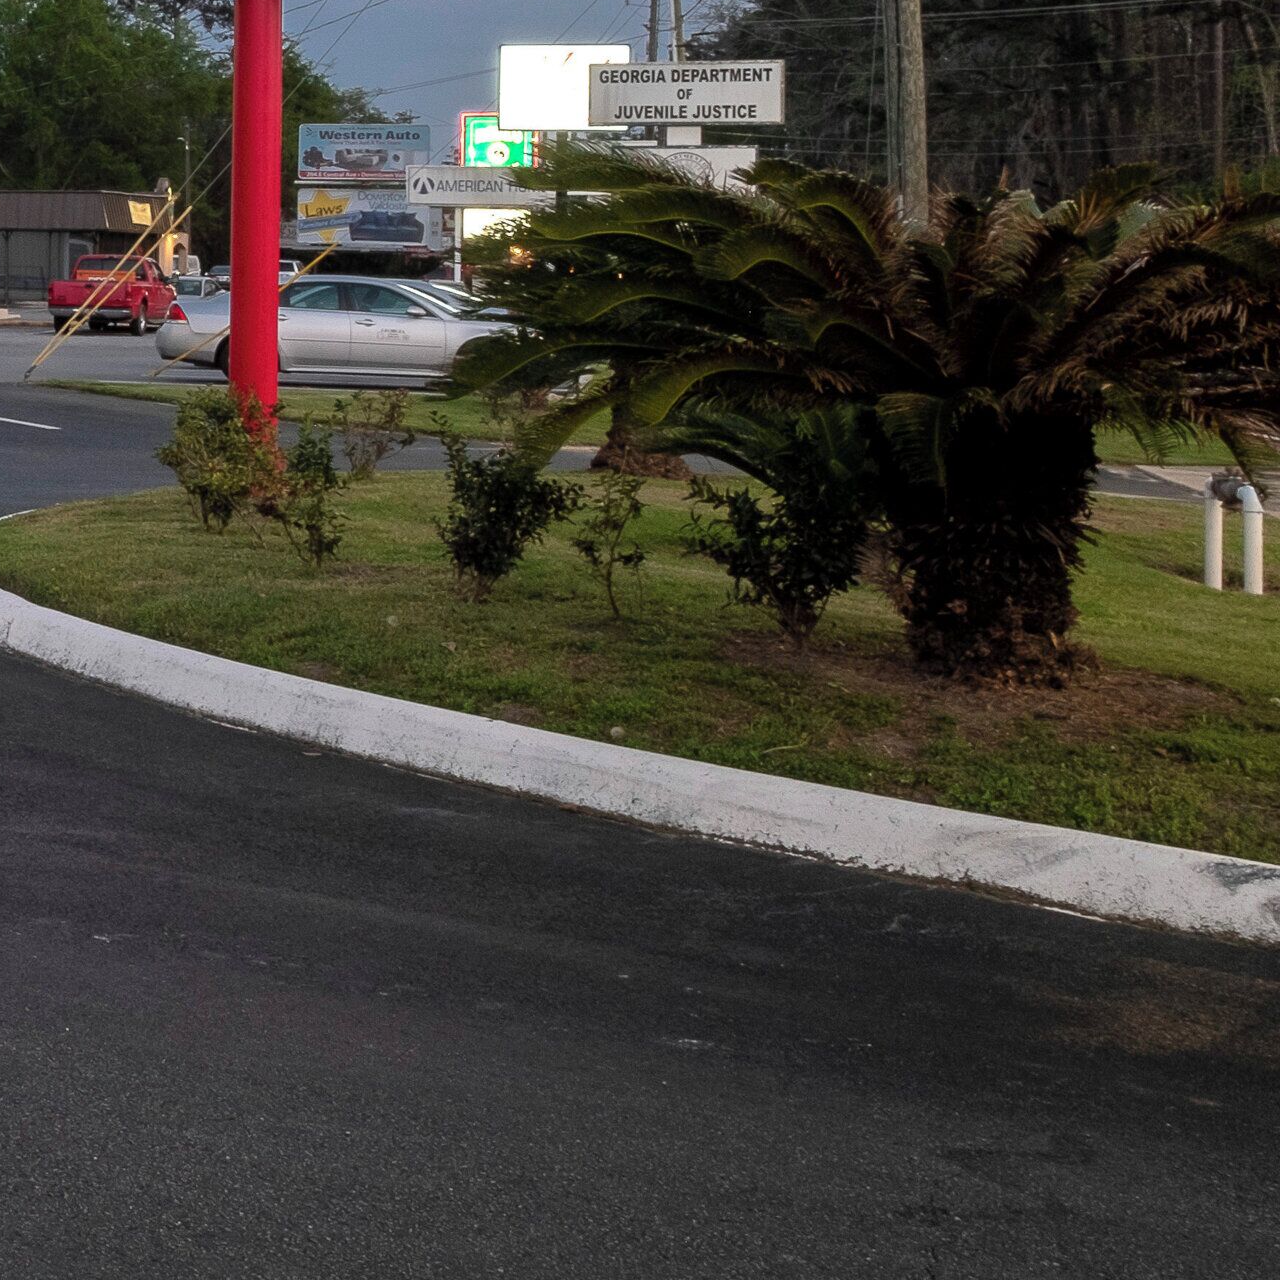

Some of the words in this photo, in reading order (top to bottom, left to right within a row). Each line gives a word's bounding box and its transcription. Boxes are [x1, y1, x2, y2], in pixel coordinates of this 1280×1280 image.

[599, 69, 666, 84] GEORGIA
[671, 68, 773, 83] DEPARTMENT
[677, 88, 693, 100] OF
[614, 105, 688, 119] JUVENILE
[692, 104, 757, 119] JUSTICE
[319, 130, 381, 140] Western
[385, 130, 421, 140] Auto
[436, 180, 503, 193] AMERICAN
[304, 203, 343, 218] Laws
